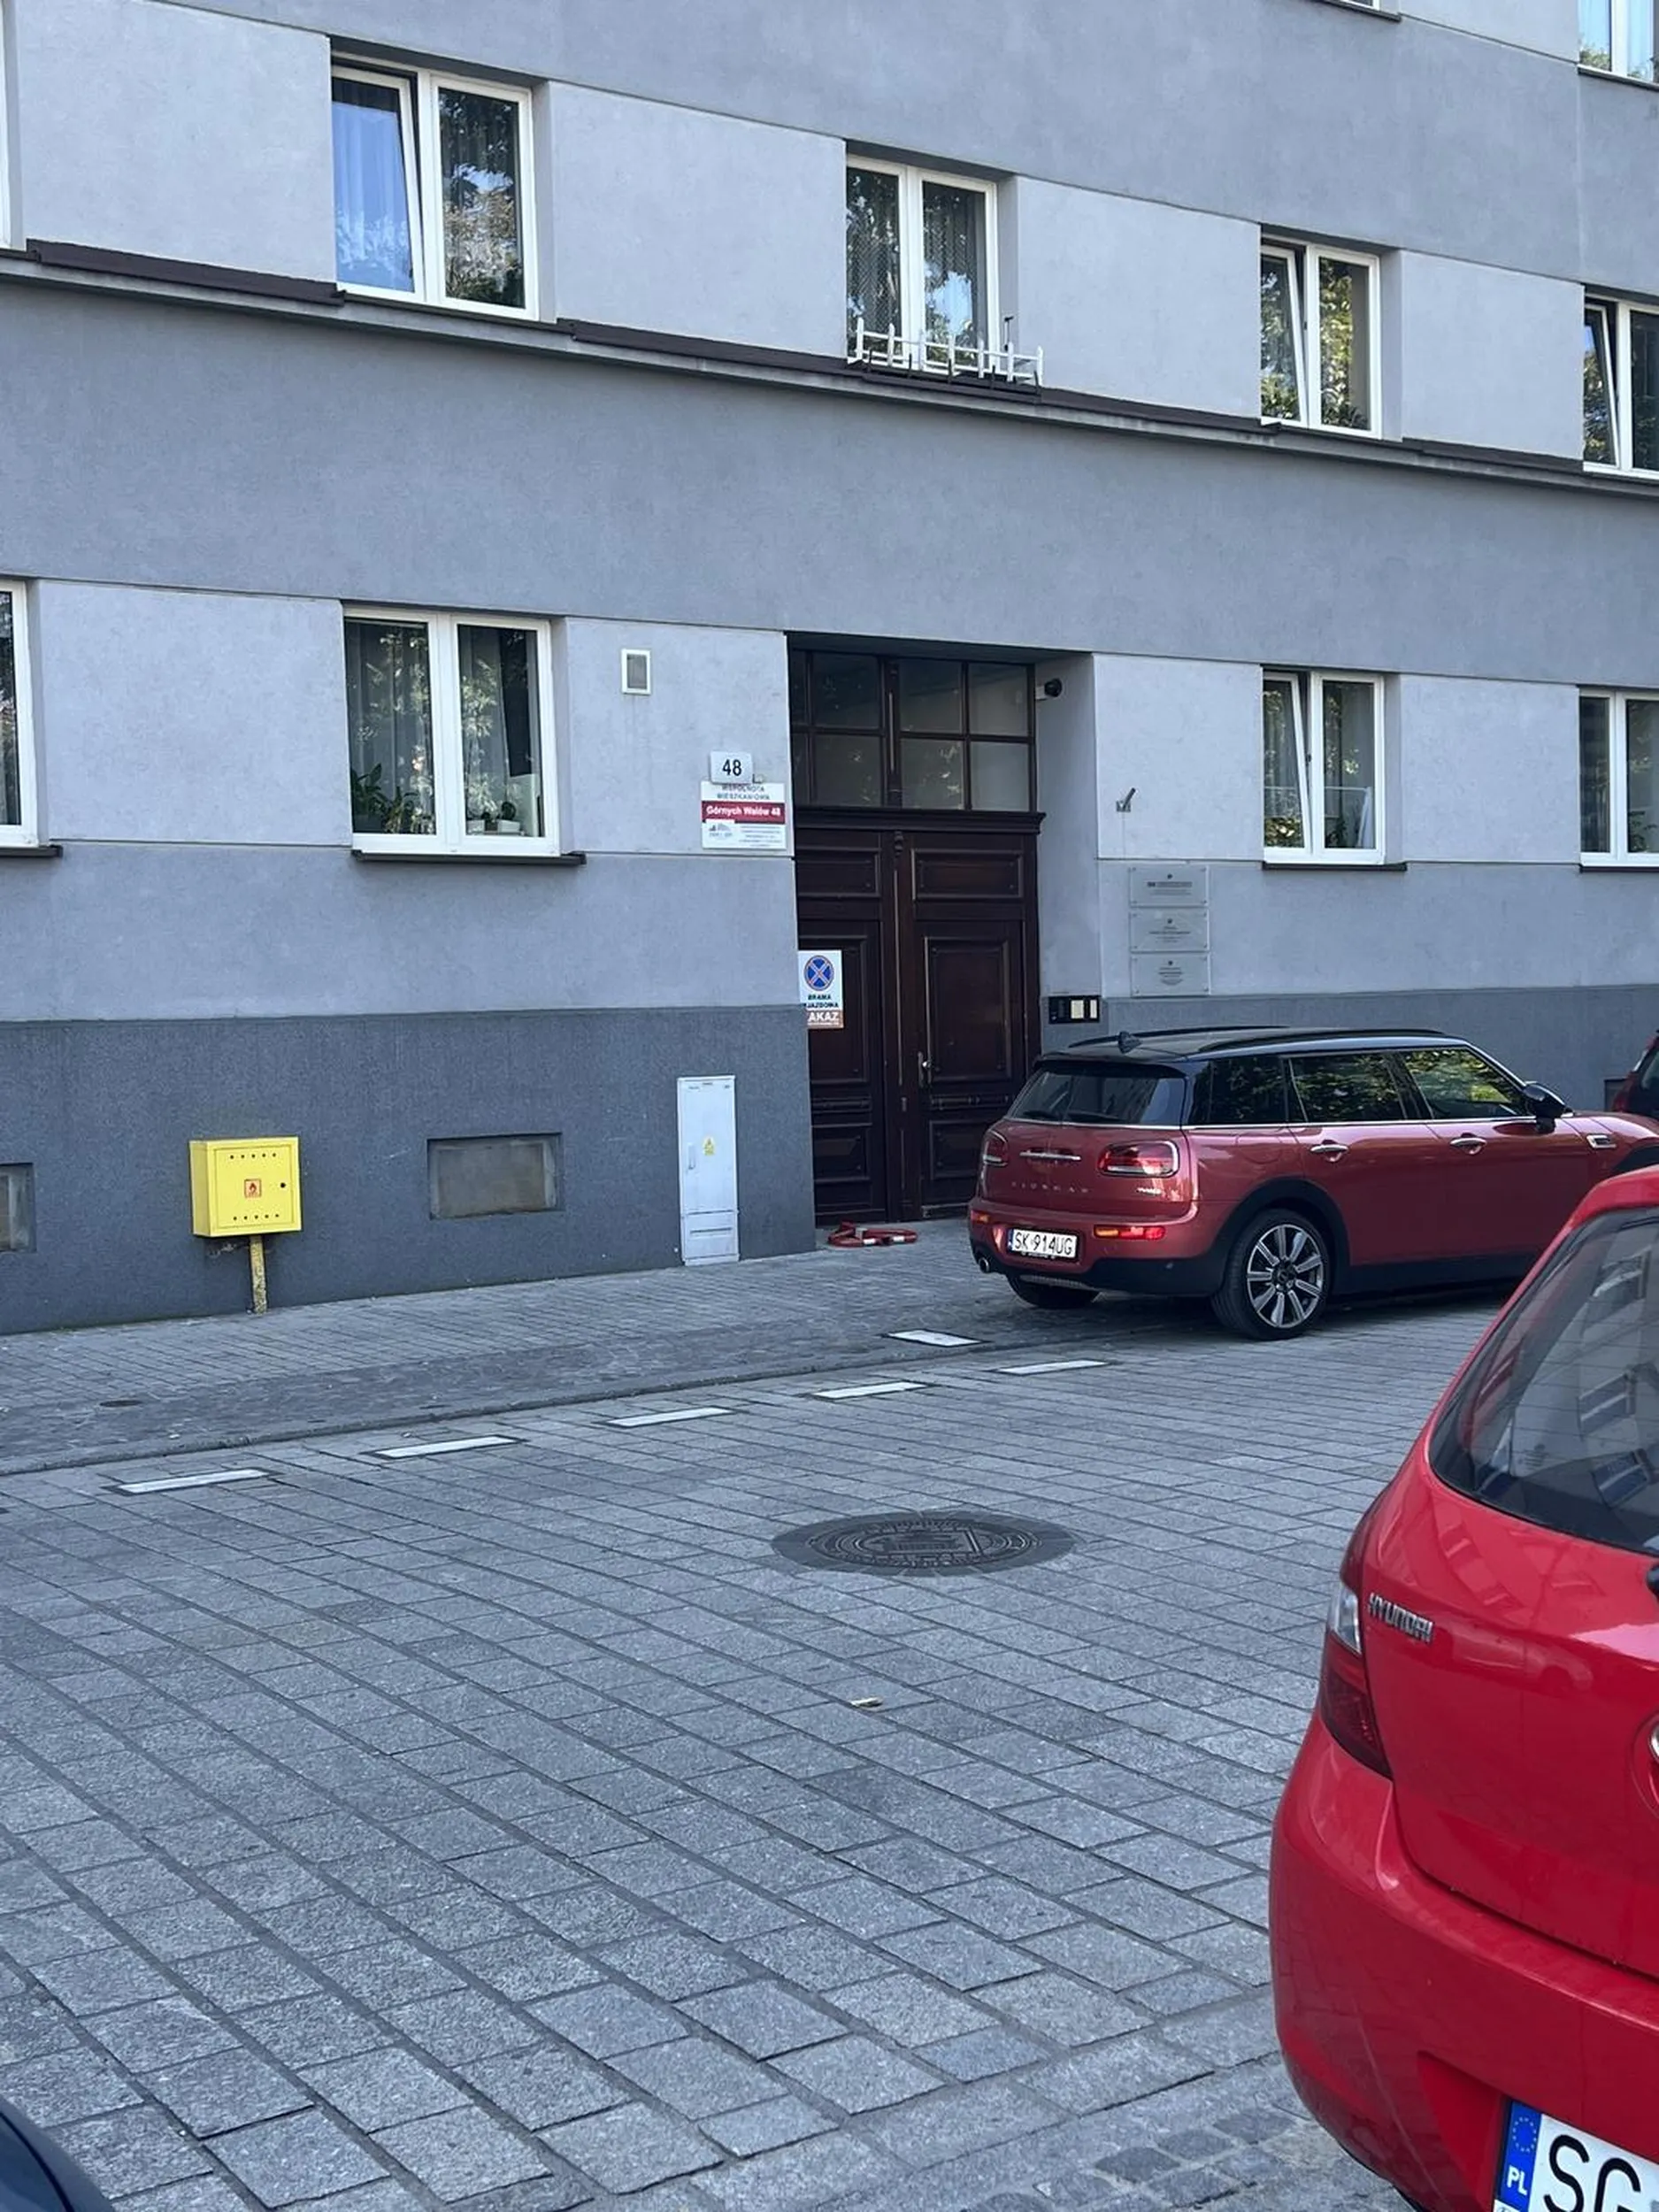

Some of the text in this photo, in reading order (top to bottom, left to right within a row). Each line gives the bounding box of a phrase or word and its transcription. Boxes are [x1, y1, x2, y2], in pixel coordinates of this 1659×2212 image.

[722, 759, 742, 777] 48
[706, 805, 742, 817] Górnych
[806, 1011, 840, 1022] AKAZ
[1014, 1232, 1073, 1256] SK 914UG
[1367, 1592, 1433, 1644] HYUNDAI
[1507, 2165, 1528, 2196] PL
[1543, 2134, 1641, 2212] SG
